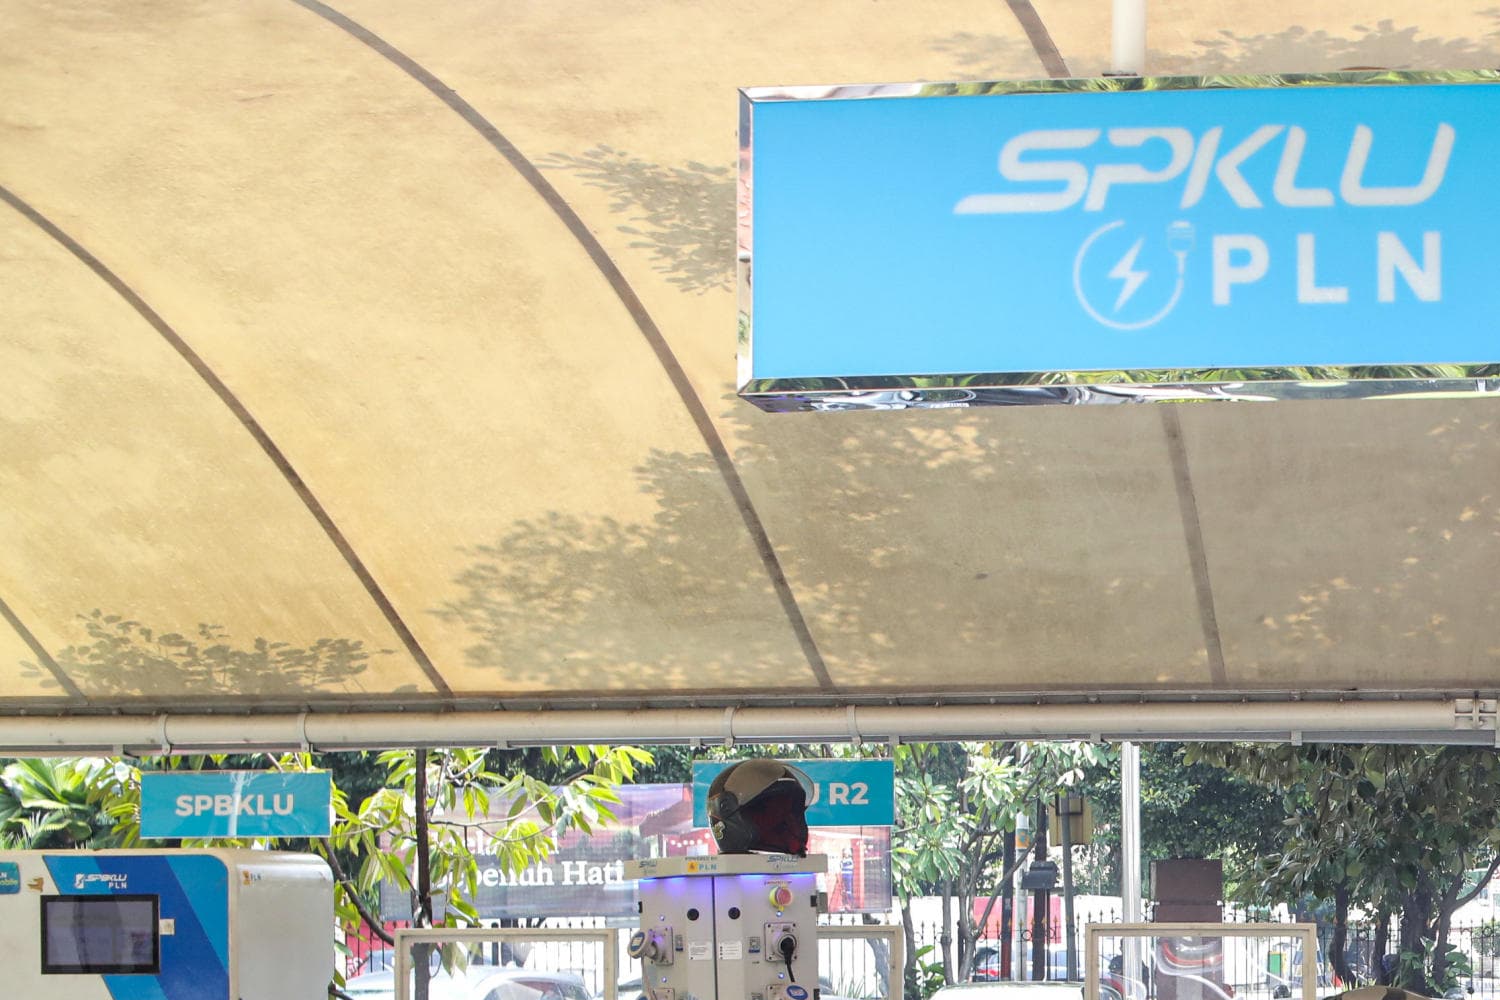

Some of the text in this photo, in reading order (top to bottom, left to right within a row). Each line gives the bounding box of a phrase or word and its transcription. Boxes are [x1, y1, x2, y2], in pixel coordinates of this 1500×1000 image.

[952, 122, 1456, 215] SPKLU
[1212, 230, 1441, 306] PLN
[175, 793, 294, 817] SPBKLU
[829, 781, 869, 806] R2
[561, 860, 625, 886] Hati
